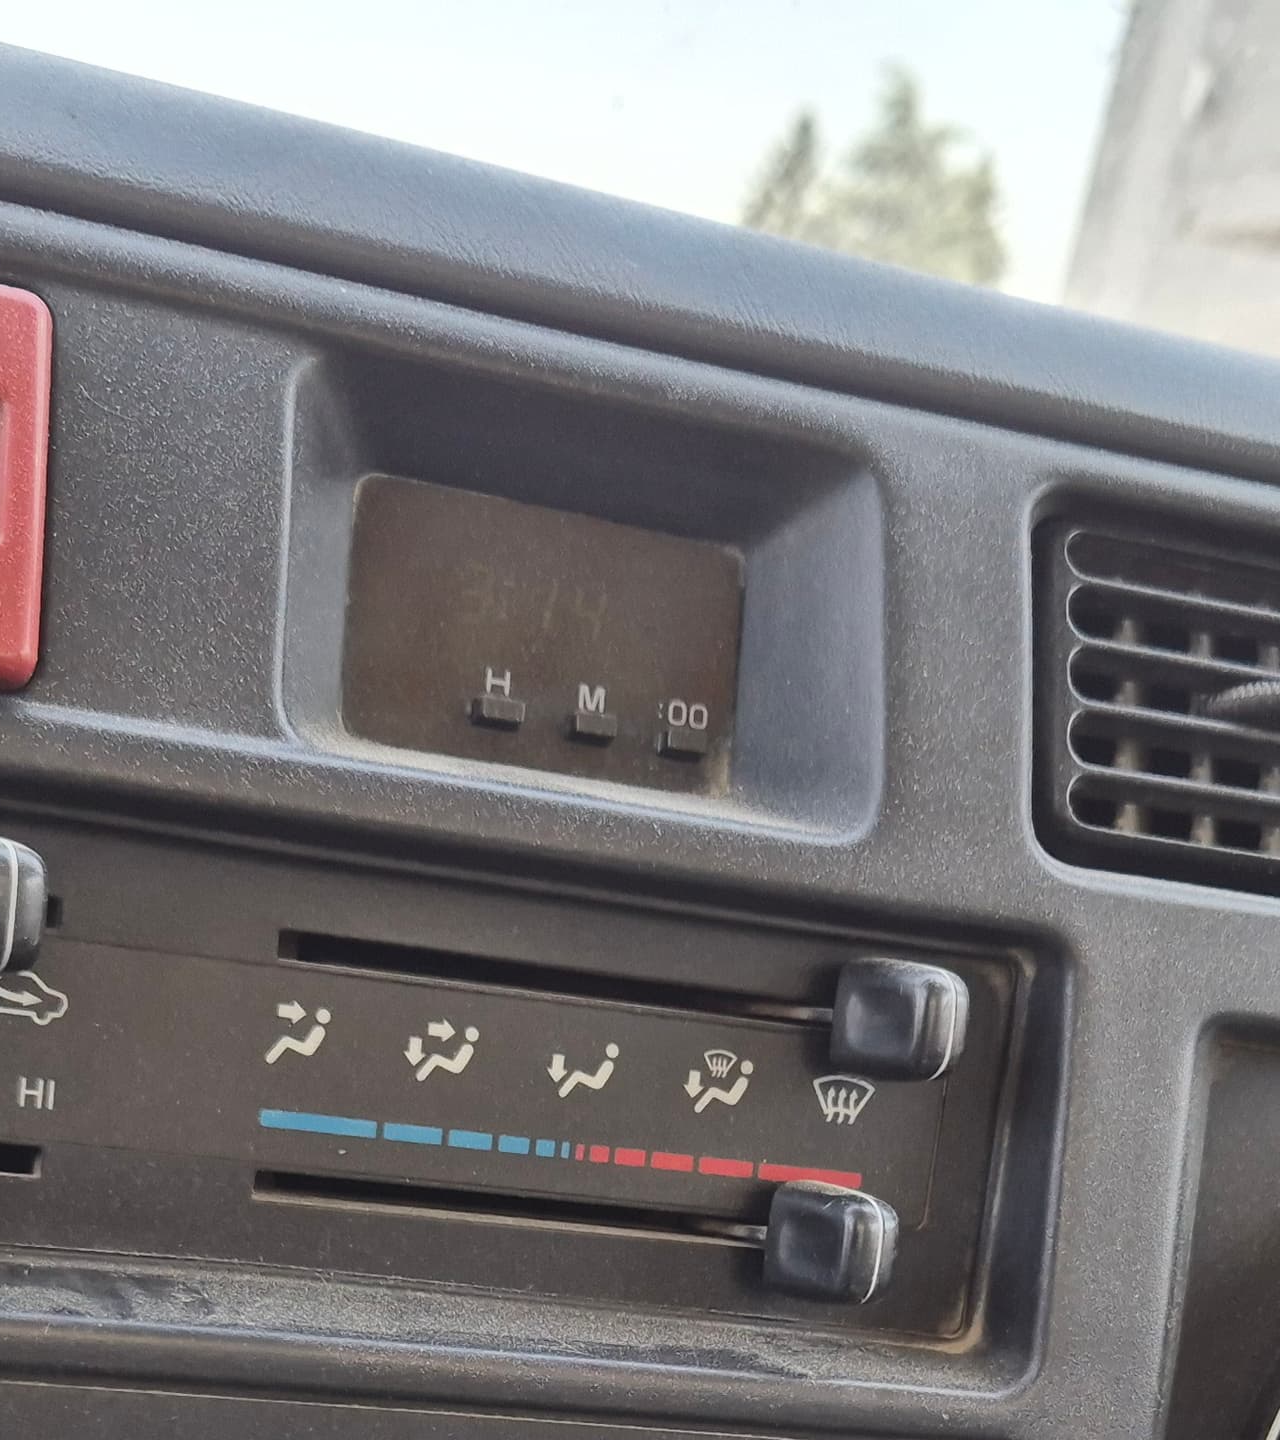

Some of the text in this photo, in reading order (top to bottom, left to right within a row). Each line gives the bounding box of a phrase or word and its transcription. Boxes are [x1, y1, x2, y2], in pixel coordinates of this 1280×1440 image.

[485, 666, 511, 696] H
[577, 684, 606, 714] M
[18, 1076, 56, 1110] HI
